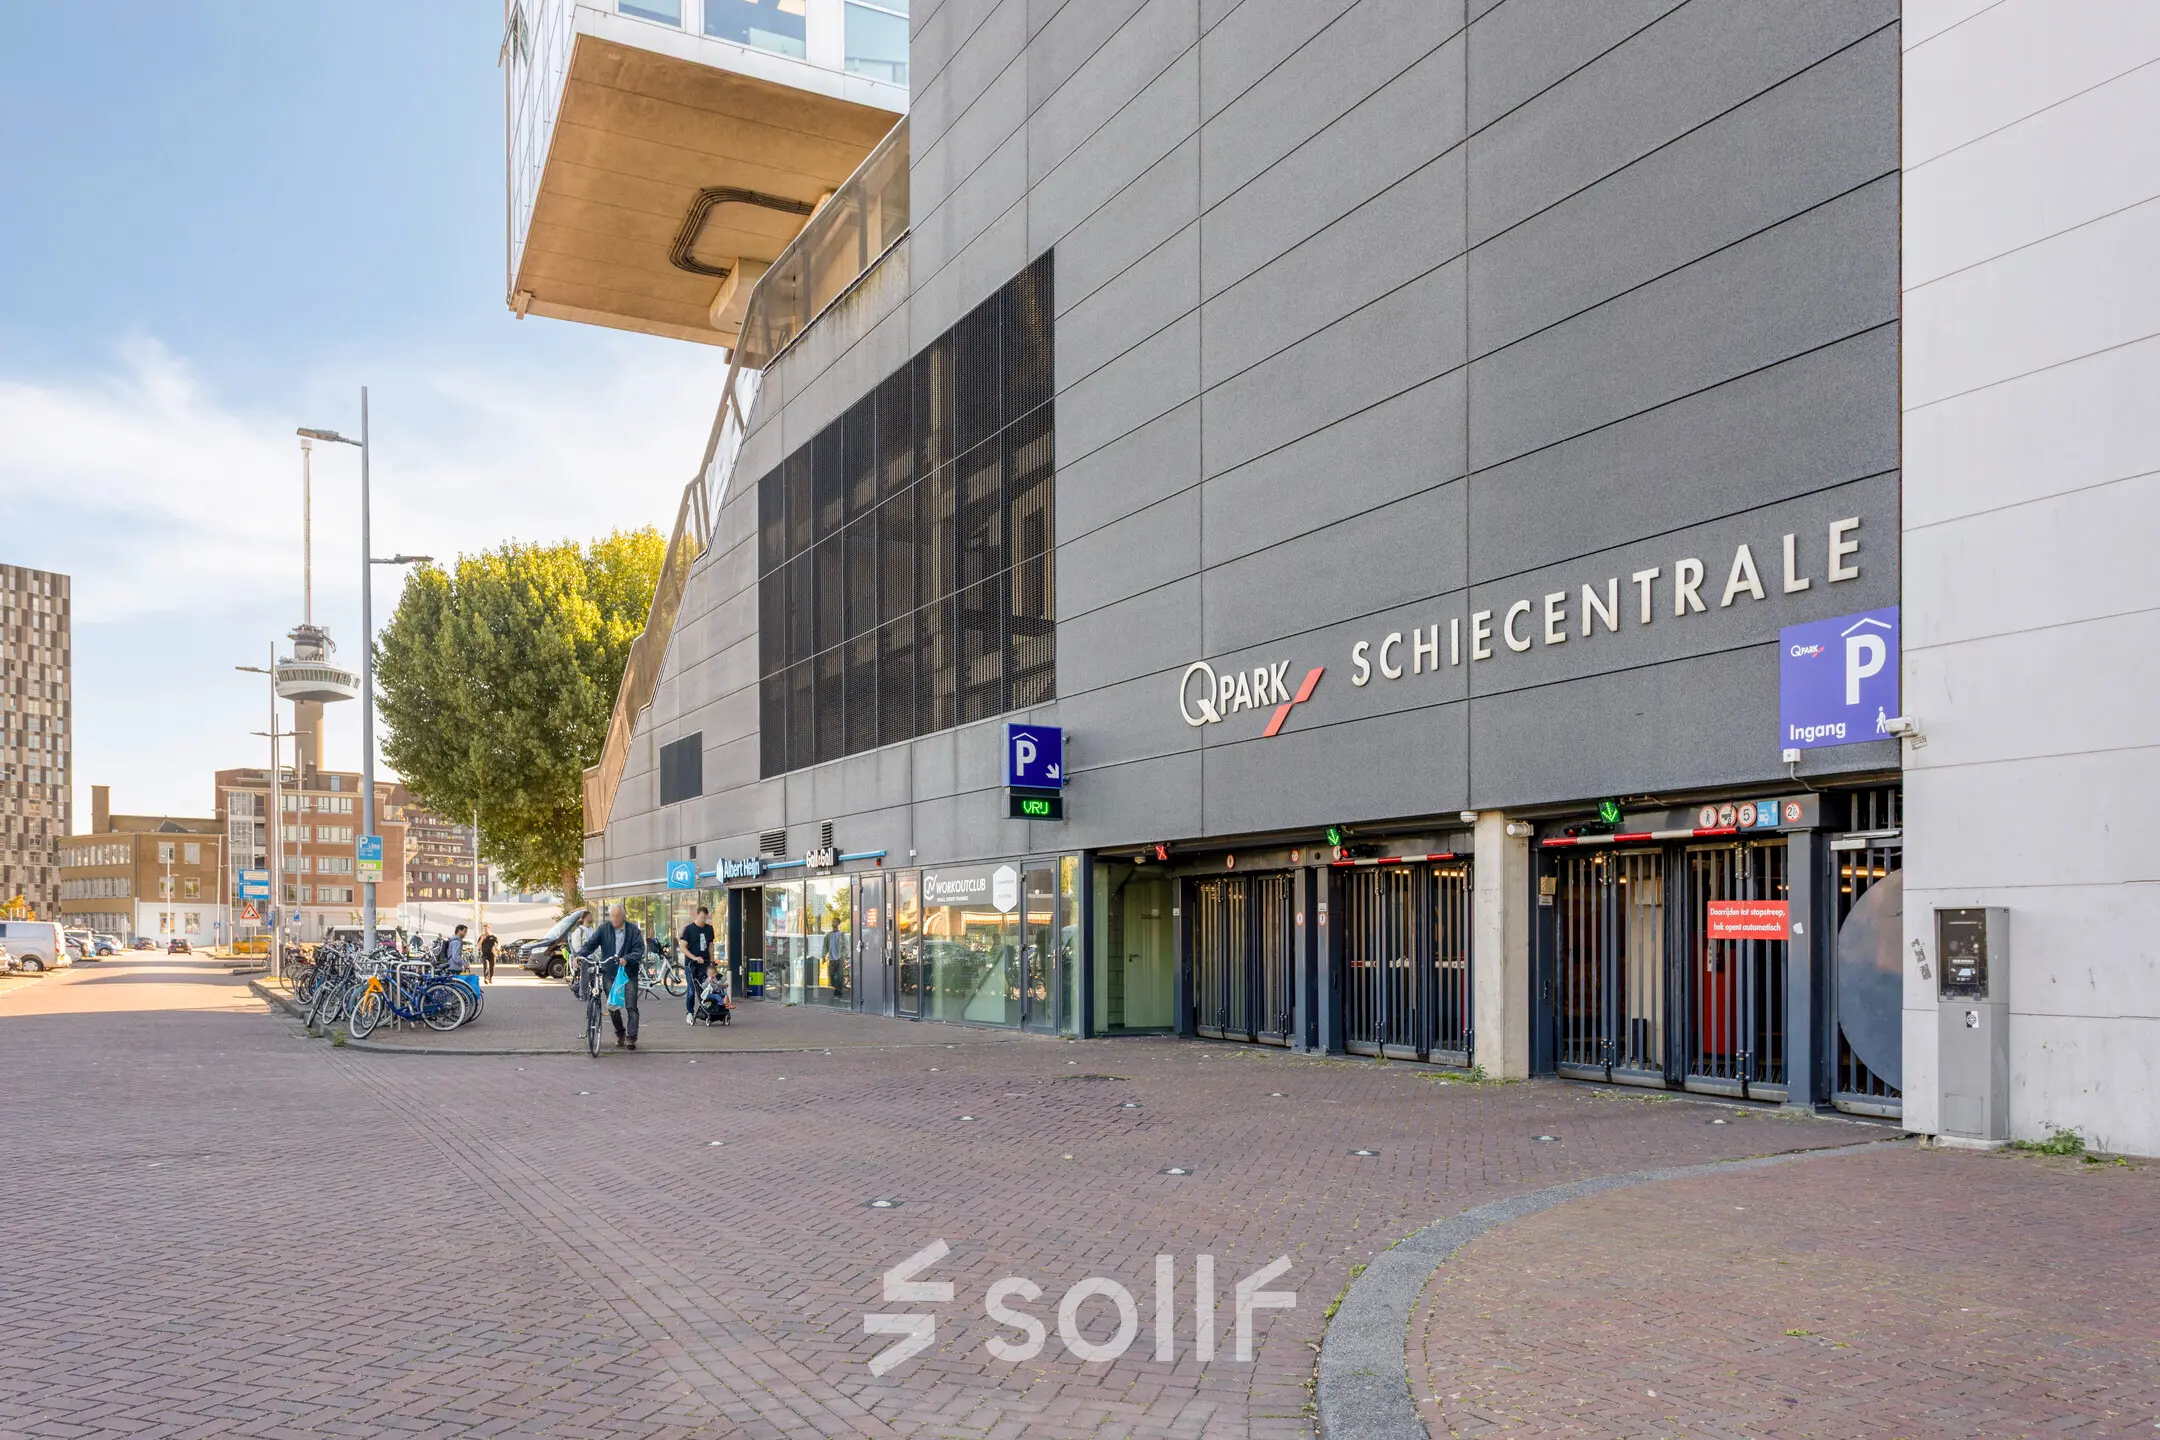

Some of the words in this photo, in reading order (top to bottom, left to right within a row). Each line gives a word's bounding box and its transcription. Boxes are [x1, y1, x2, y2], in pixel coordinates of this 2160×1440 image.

[1352, 516, 1860, 687] SCHIECENTRALE
[1846, 634, 1886, 705] P
[1789, 722, 1846, 742] Ingang
[1016, 739, 1037, 776] P
[1743, 808, 1750, 821] 5
[360, 836, 369, 848] P
[724, 860, 743, 878] Albert
[743, 857, 760, 879] Heijn
[936, 878, 986, 894] WORKOUTCLUB
[1710, 907, 1740, 918] Doorrijden
[1741, 908, 1749, 916] tot
[1750, 908, 1786, 918] stopstreep,
[1713, 922, 1725, 931] hek
[1725, 923, 1742, 932] opent
[1742, 922, 1781, 931] automatisch
